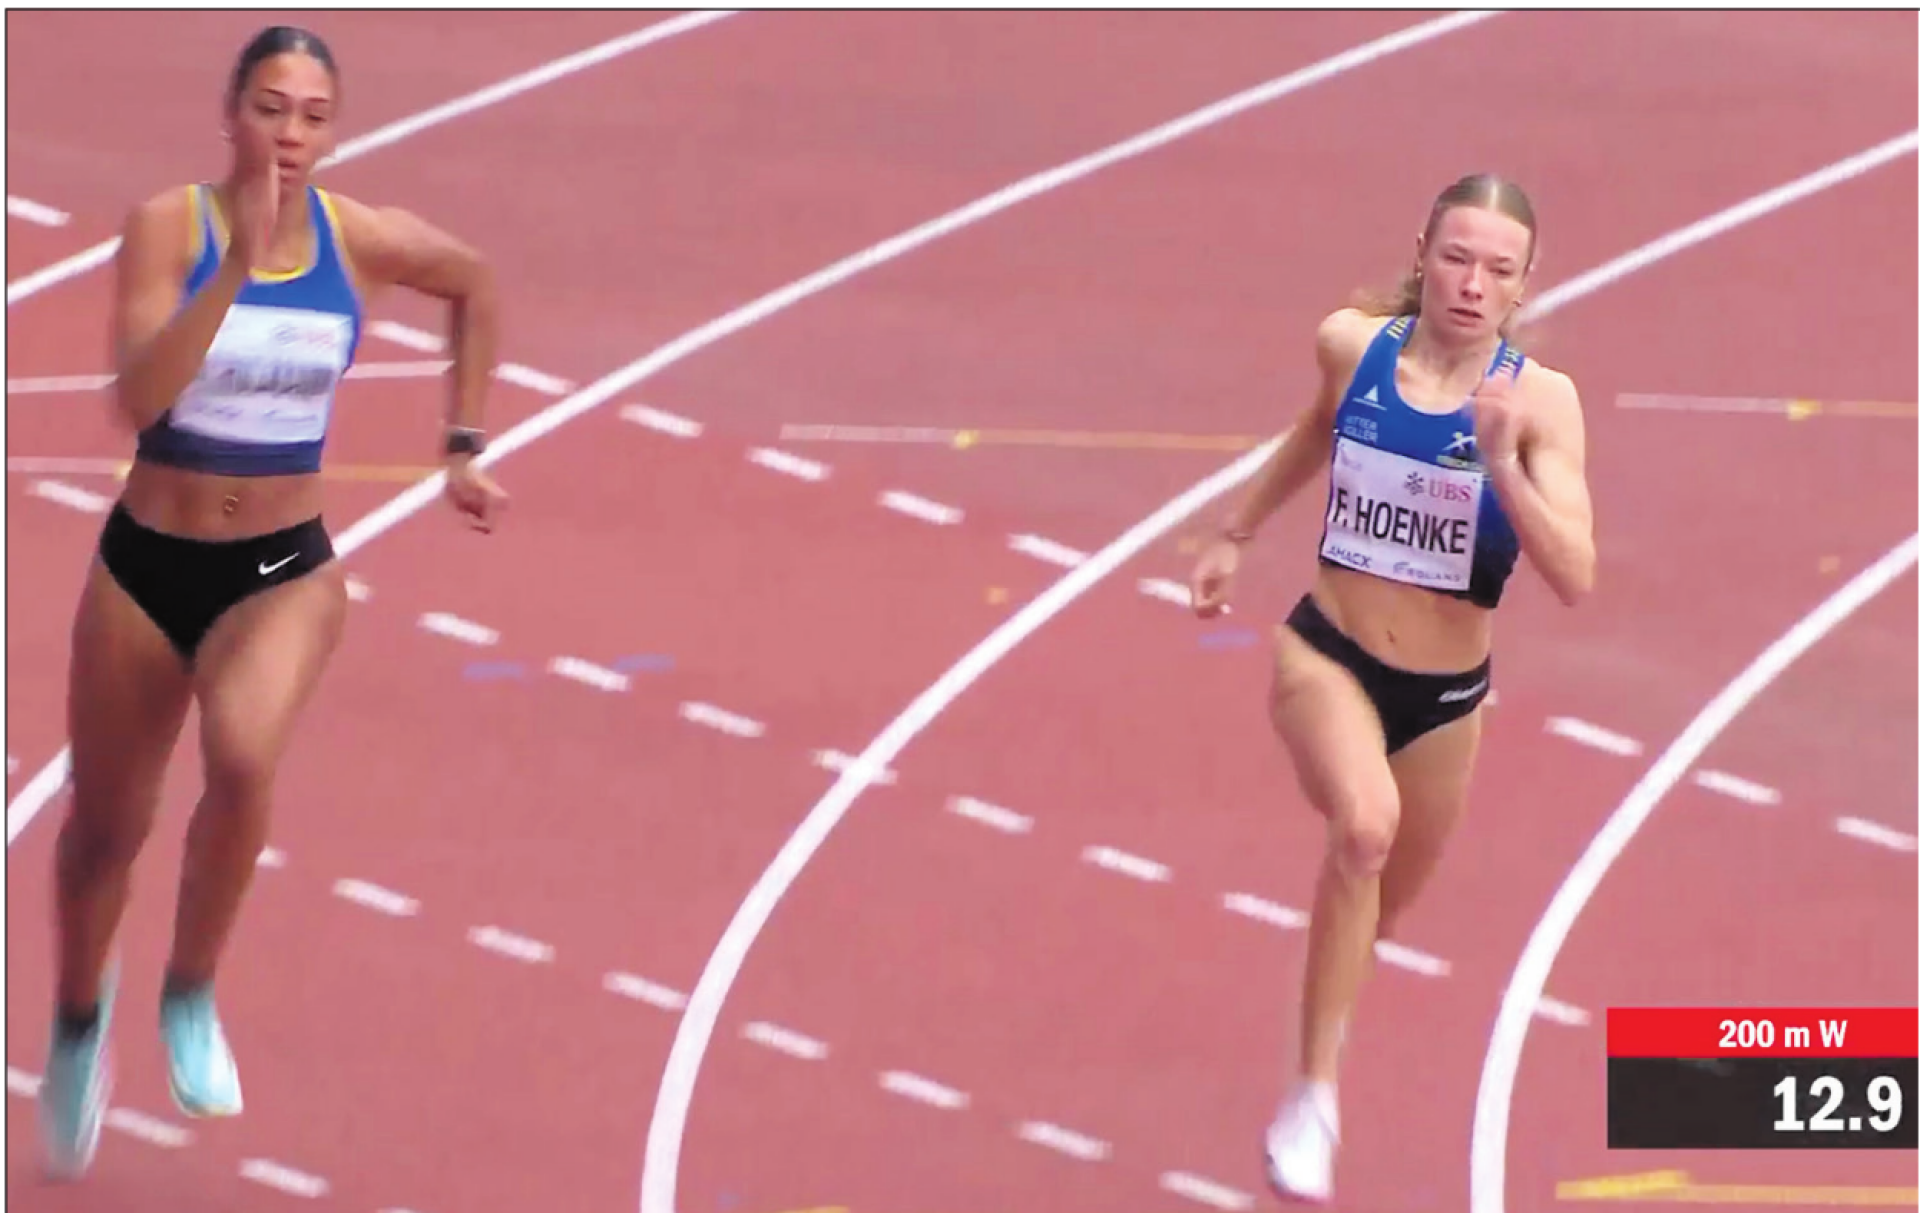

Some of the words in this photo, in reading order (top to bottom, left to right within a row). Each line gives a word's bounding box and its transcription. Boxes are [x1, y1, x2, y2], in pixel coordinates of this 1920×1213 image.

[1429, 479, 1472, 503] UBS
[1332, 487, 1349, 528] F.
[1354, 495, 1469, 554] HOENKE
